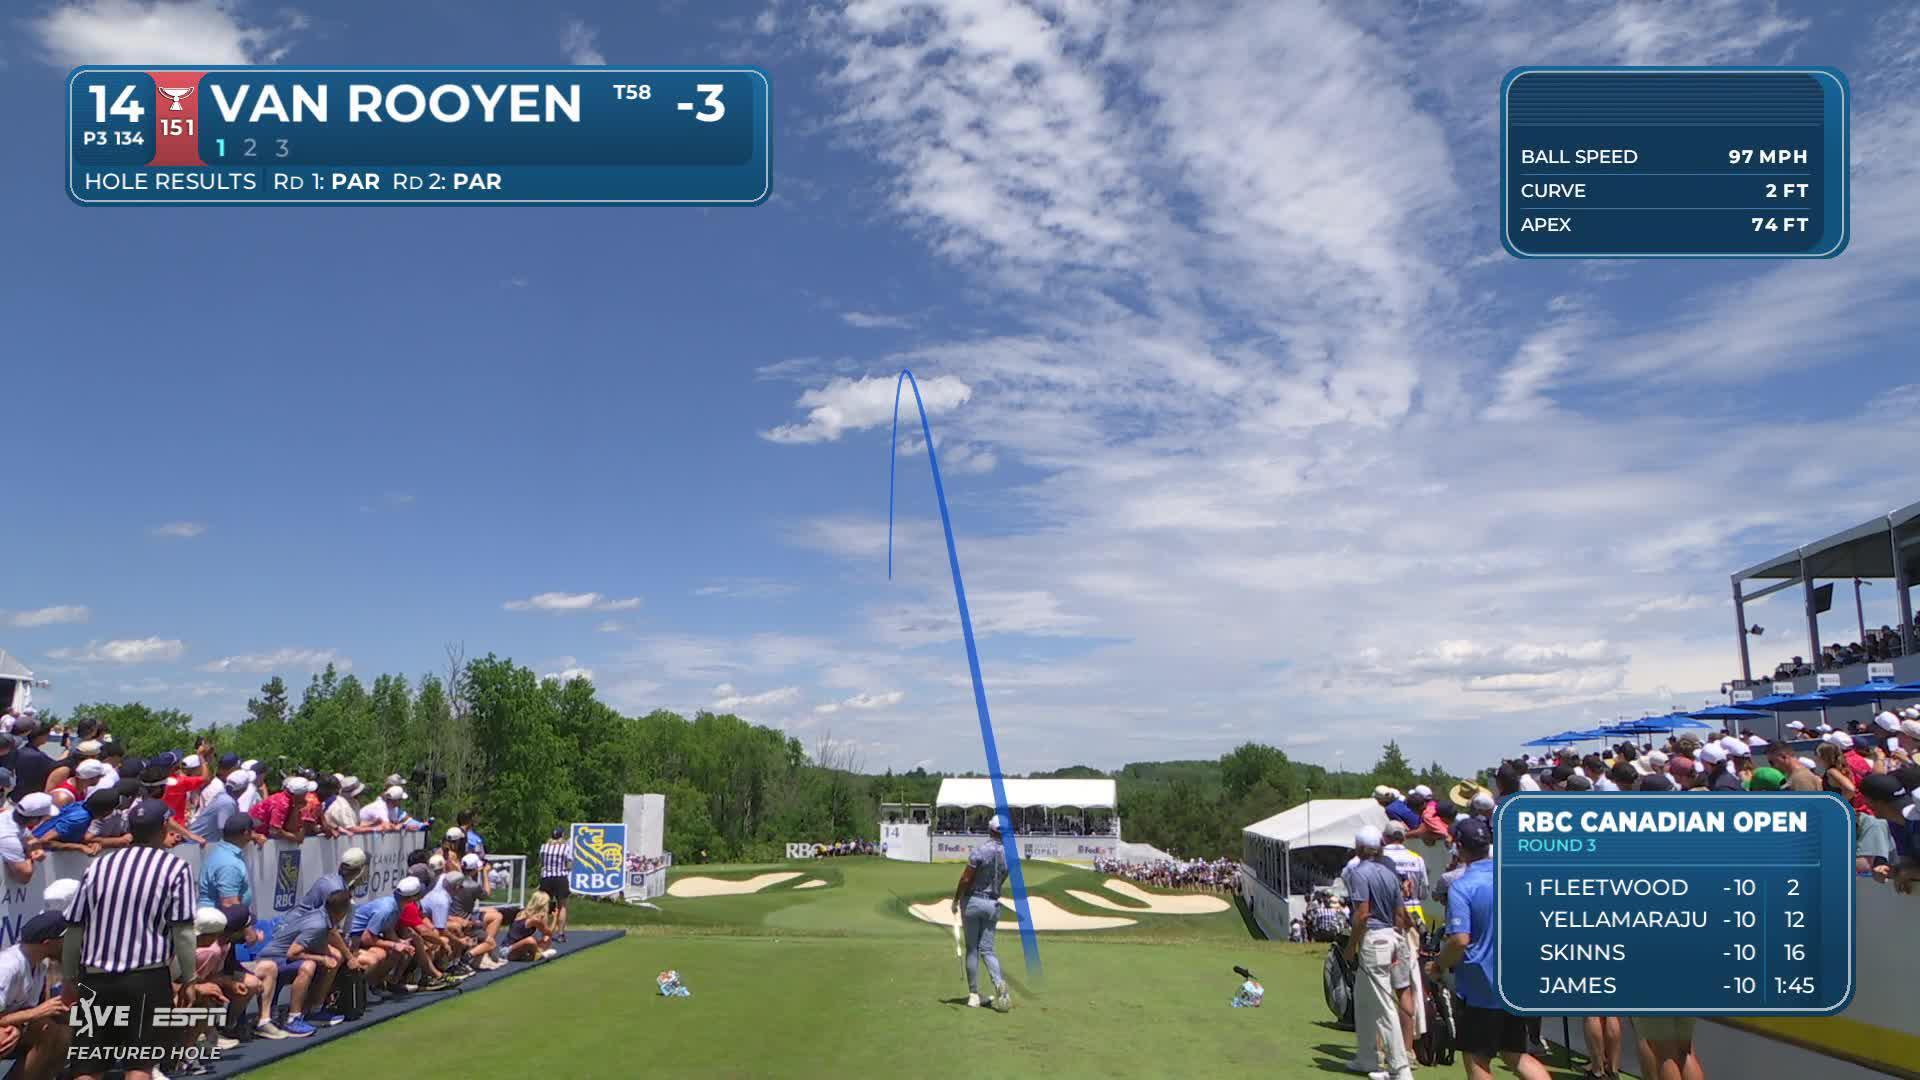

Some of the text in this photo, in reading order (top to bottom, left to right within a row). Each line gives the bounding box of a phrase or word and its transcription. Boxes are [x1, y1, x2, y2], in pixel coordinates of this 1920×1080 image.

[885, 826, 900, 838] 14
[575, 872, 620, 889] RBC
[275, 891, 297, 908] RBC
